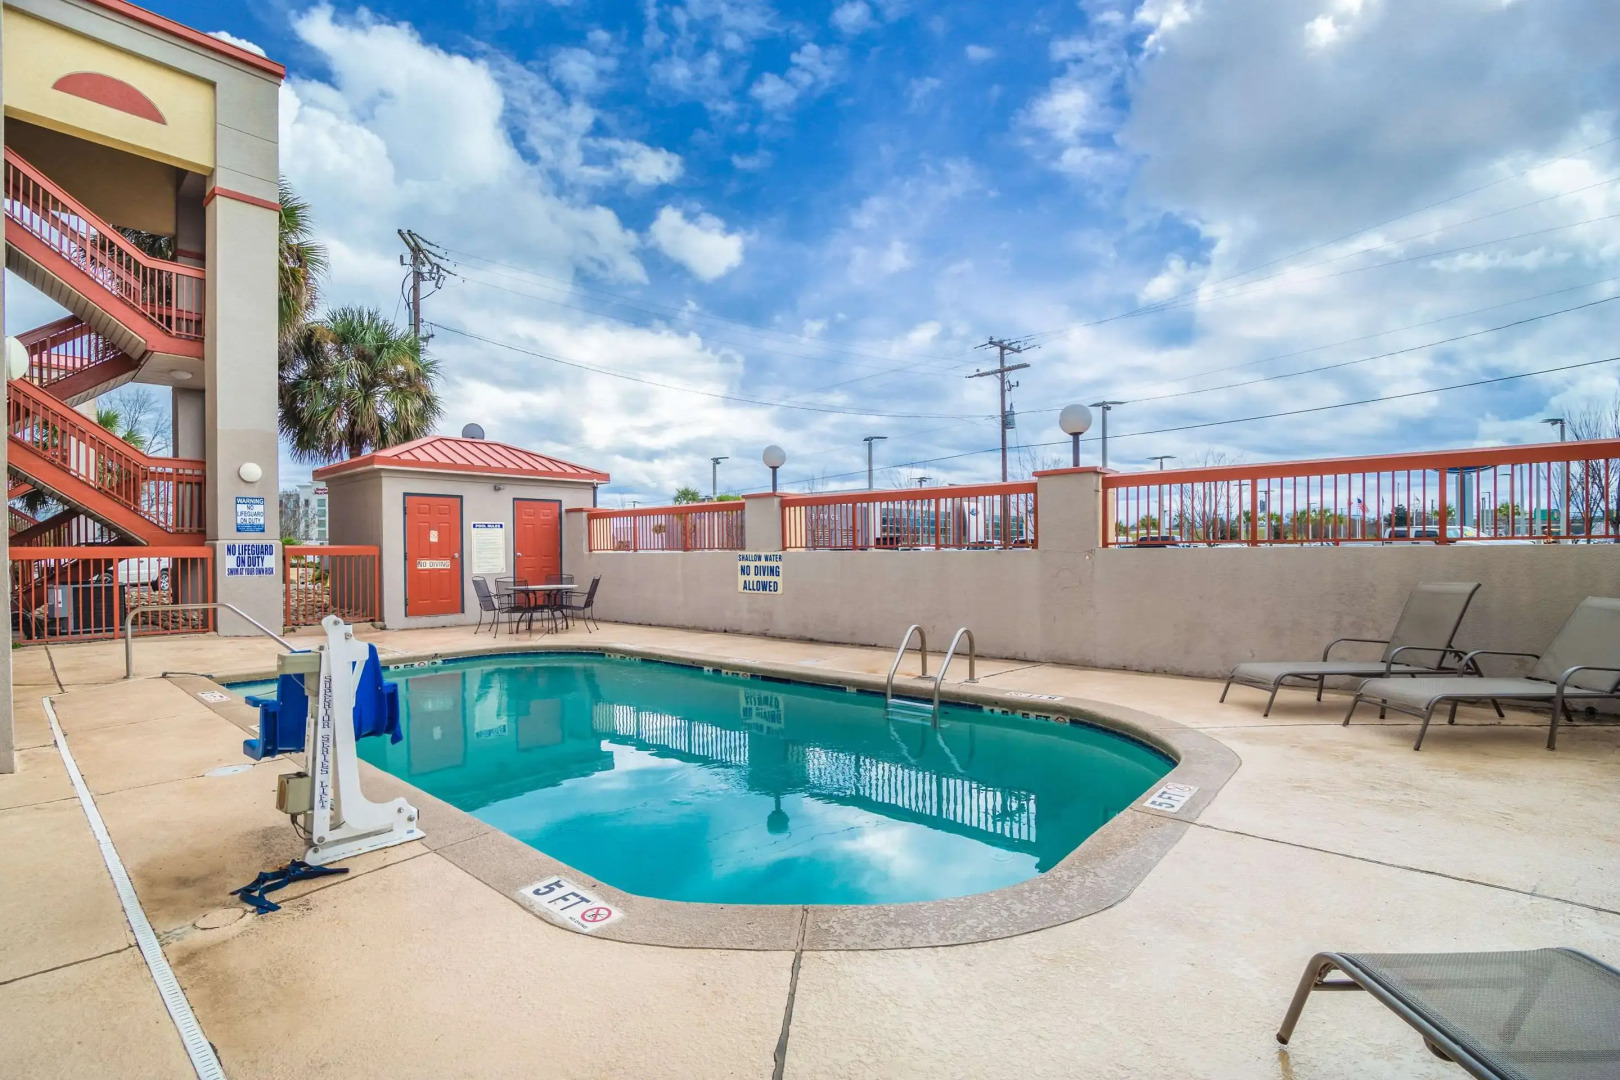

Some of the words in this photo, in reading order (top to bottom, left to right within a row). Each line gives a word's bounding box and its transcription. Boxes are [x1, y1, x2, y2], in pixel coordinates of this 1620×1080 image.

[226, 544, 236, 556] NO
[238, 544, 274, 556] LIFEGUARD
[236, 556, 246, 568] ON
[247, 556, 265, 568] DUTY
[227, 568, 239, 576] SWIM
[240, 568, 244, 576] AT
[244, 568, 255, 576] YOUR
[256, 568, 264, 576] OWN
[265, 568, 274, 576] RISK
[740, 564, 750, 576] NO
[754, 565, 780, 576] DIVING
[742, 580, 778, 592] ALLOWED
[1156, 791, 1185, 802] FT
[1150, 800, 1175, 808] 5
[532, 880, 564, 896] 5
[548, 891, 592, 911] FT
